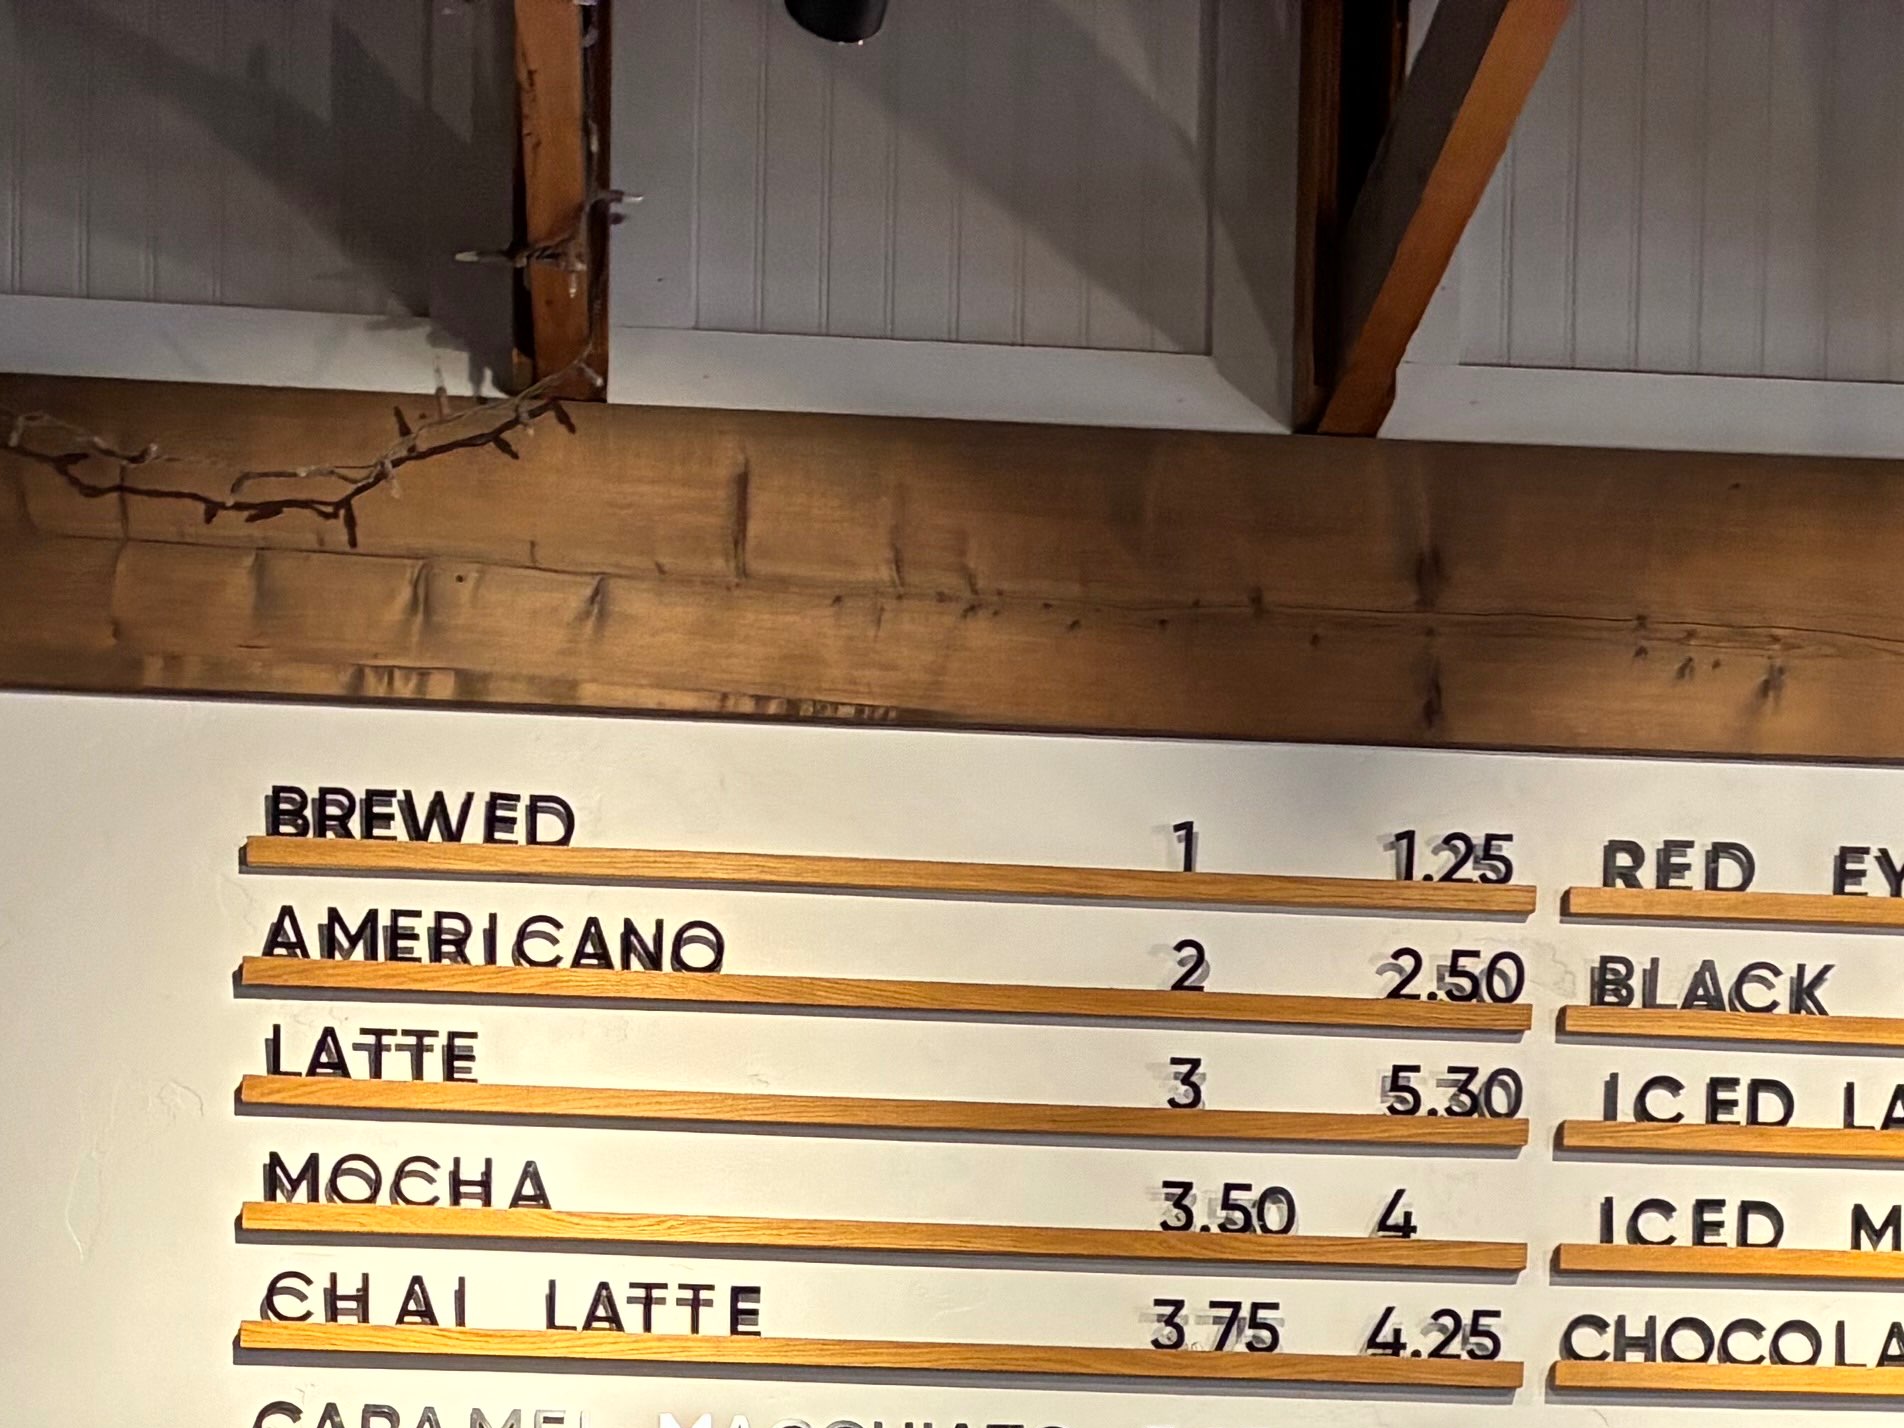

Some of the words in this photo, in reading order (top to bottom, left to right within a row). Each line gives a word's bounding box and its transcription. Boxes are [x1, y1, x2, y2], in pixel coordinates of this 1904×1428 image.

[268, 784, 576, 847] BREWED
[1172, 821, 1197, 872] 1
[1394, 829, 1515, 885] 1.25
[1603, 839, 1756, 892] RED
[263, 905, 725, 974] AMERICANO
[1171, 939, 1207, 992] 2
[1385, 947, 1525, 1003] 2.50
[1593, 955, 1836, 1015] BLACK
[268, 1024, 479, 1082] LATTE
[1167, 1058, 1204, 1109] 3
[1385, 1064, 1523, 1118] 5.30
[1604, 1072, 1795, 1127] ICED
[266, 1151, 552, 1210] MOCHA
[1159, 1180, 1296, 1234] 3.50
[1376, 1188, 1418, 1239] 4
[1600, 1196, 1785, 1248] ICED
[264, 1271, 467, 1328] CHAI
[545, 1278, 762, 1336] LATTE
[1150, 1298, 1281, 1353] 3.75
[1366, 1306, 1502, 1361] 4.25
